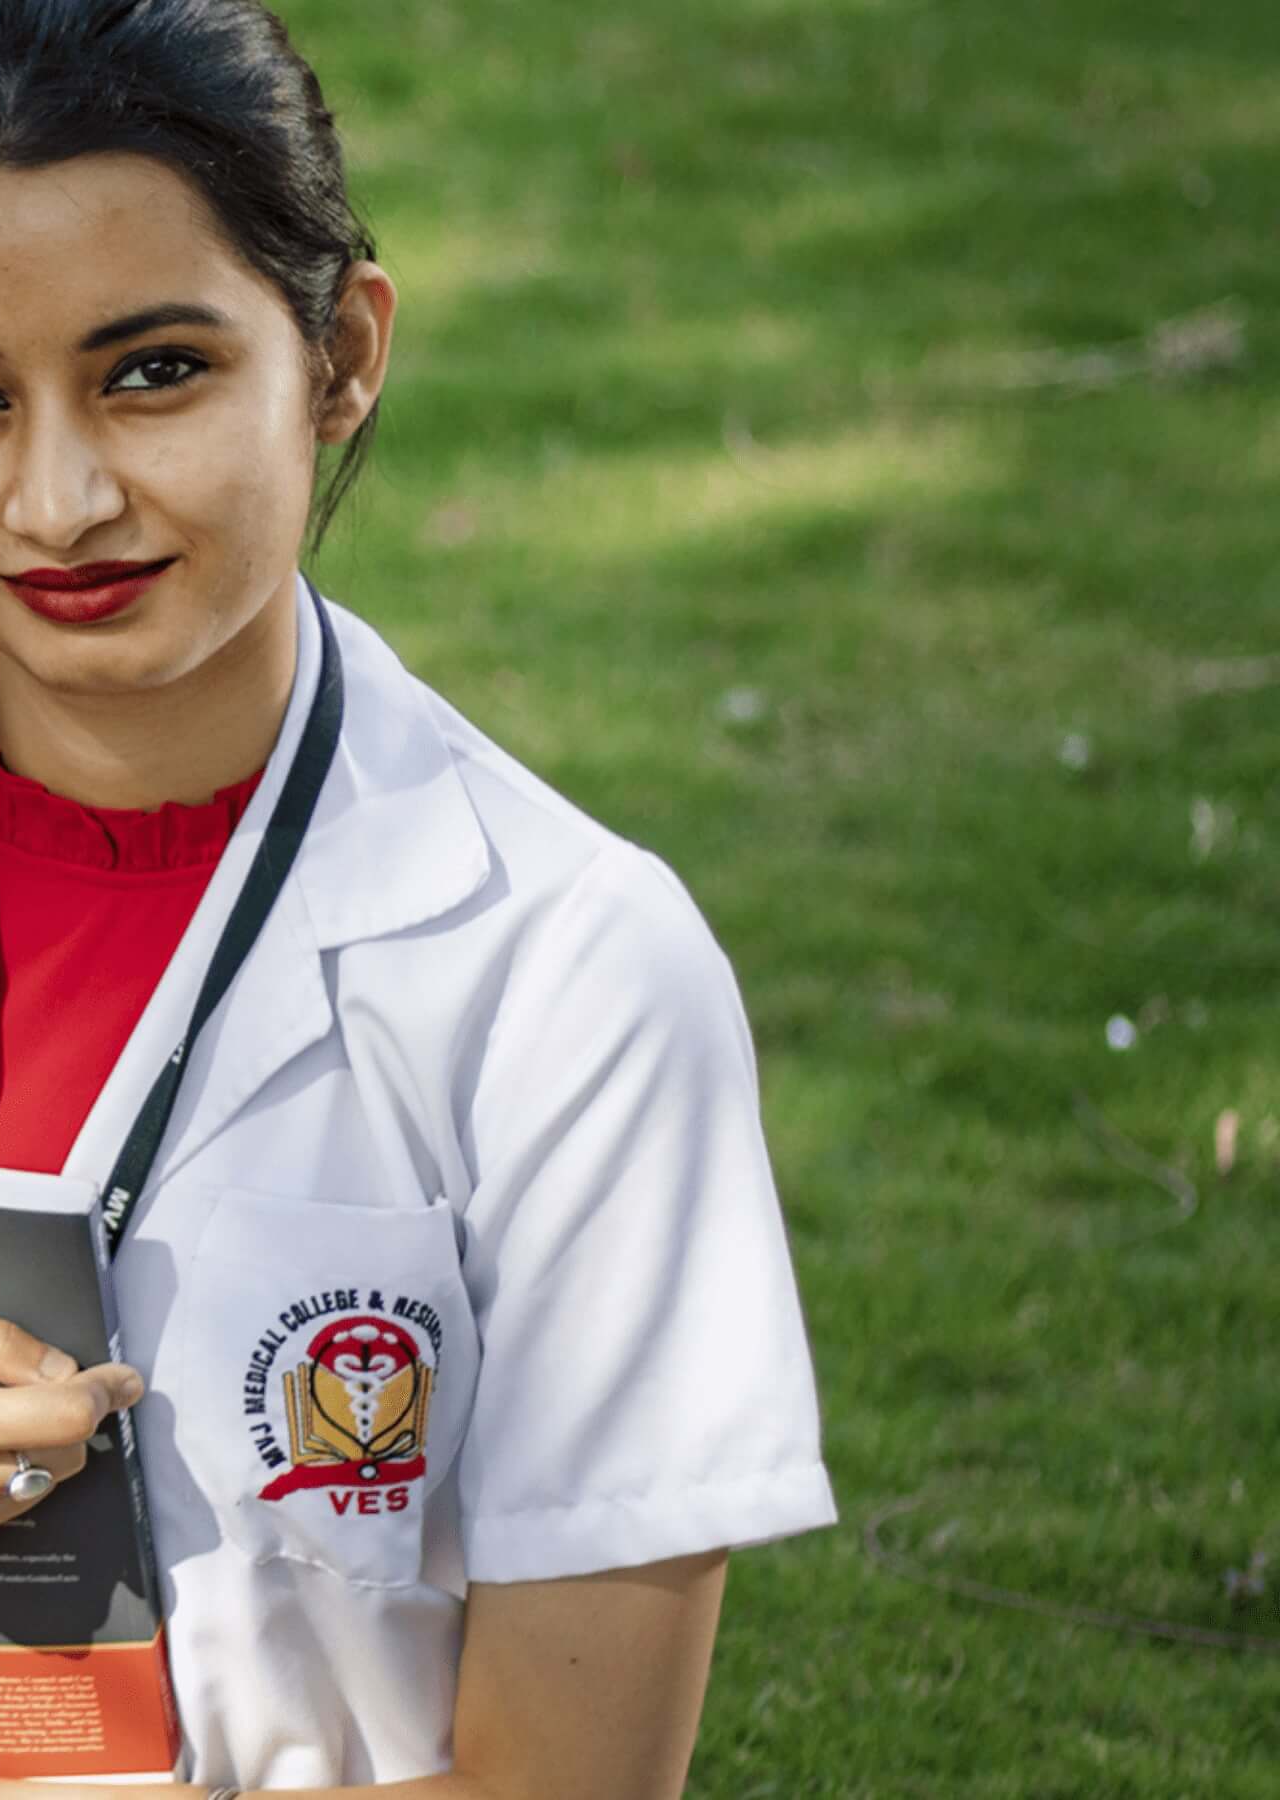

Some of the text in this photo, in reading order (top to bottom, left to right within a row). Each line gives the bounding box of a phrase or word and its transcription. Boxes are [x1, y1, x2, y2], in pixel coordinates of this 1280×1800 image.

[278, 1288, 360, 1333] COLLEGE
[367, 1290, 387, 1313] &
[243, 1328, 288, 1415] MEDICAL
[248, 1422, 289, 1470] MVJ
[328, 1486, 410, 1516] VES
